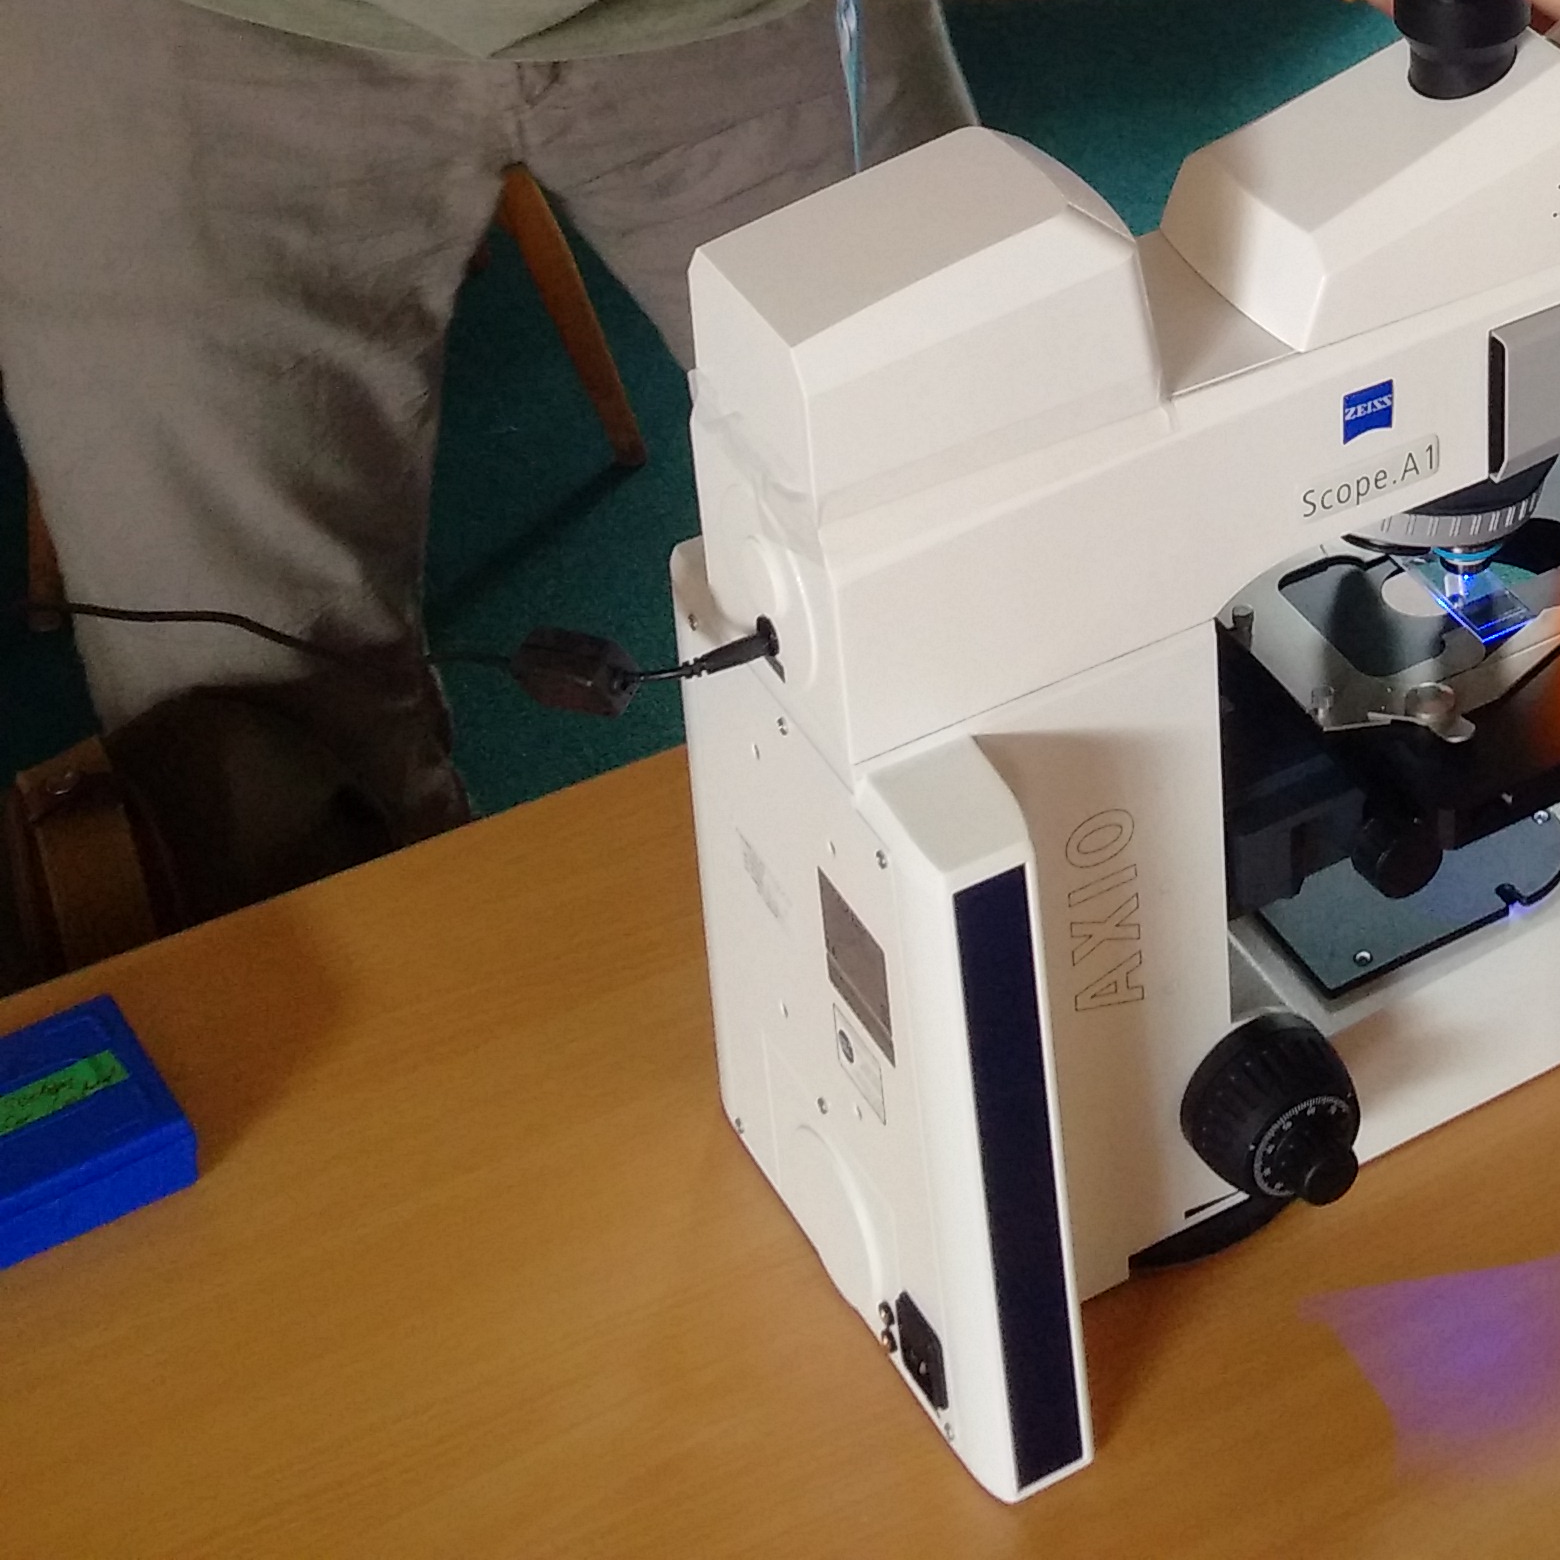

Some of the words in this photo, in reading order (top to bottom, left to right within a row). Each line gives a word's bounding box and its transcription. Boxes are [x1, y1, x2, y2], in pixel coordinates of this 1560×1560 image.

[1344, 394, 1392, 421] ZEISS
[1302, 444, 1434, 518] Scope.A1
[1065, 808, 1145, 1012] AXIO
